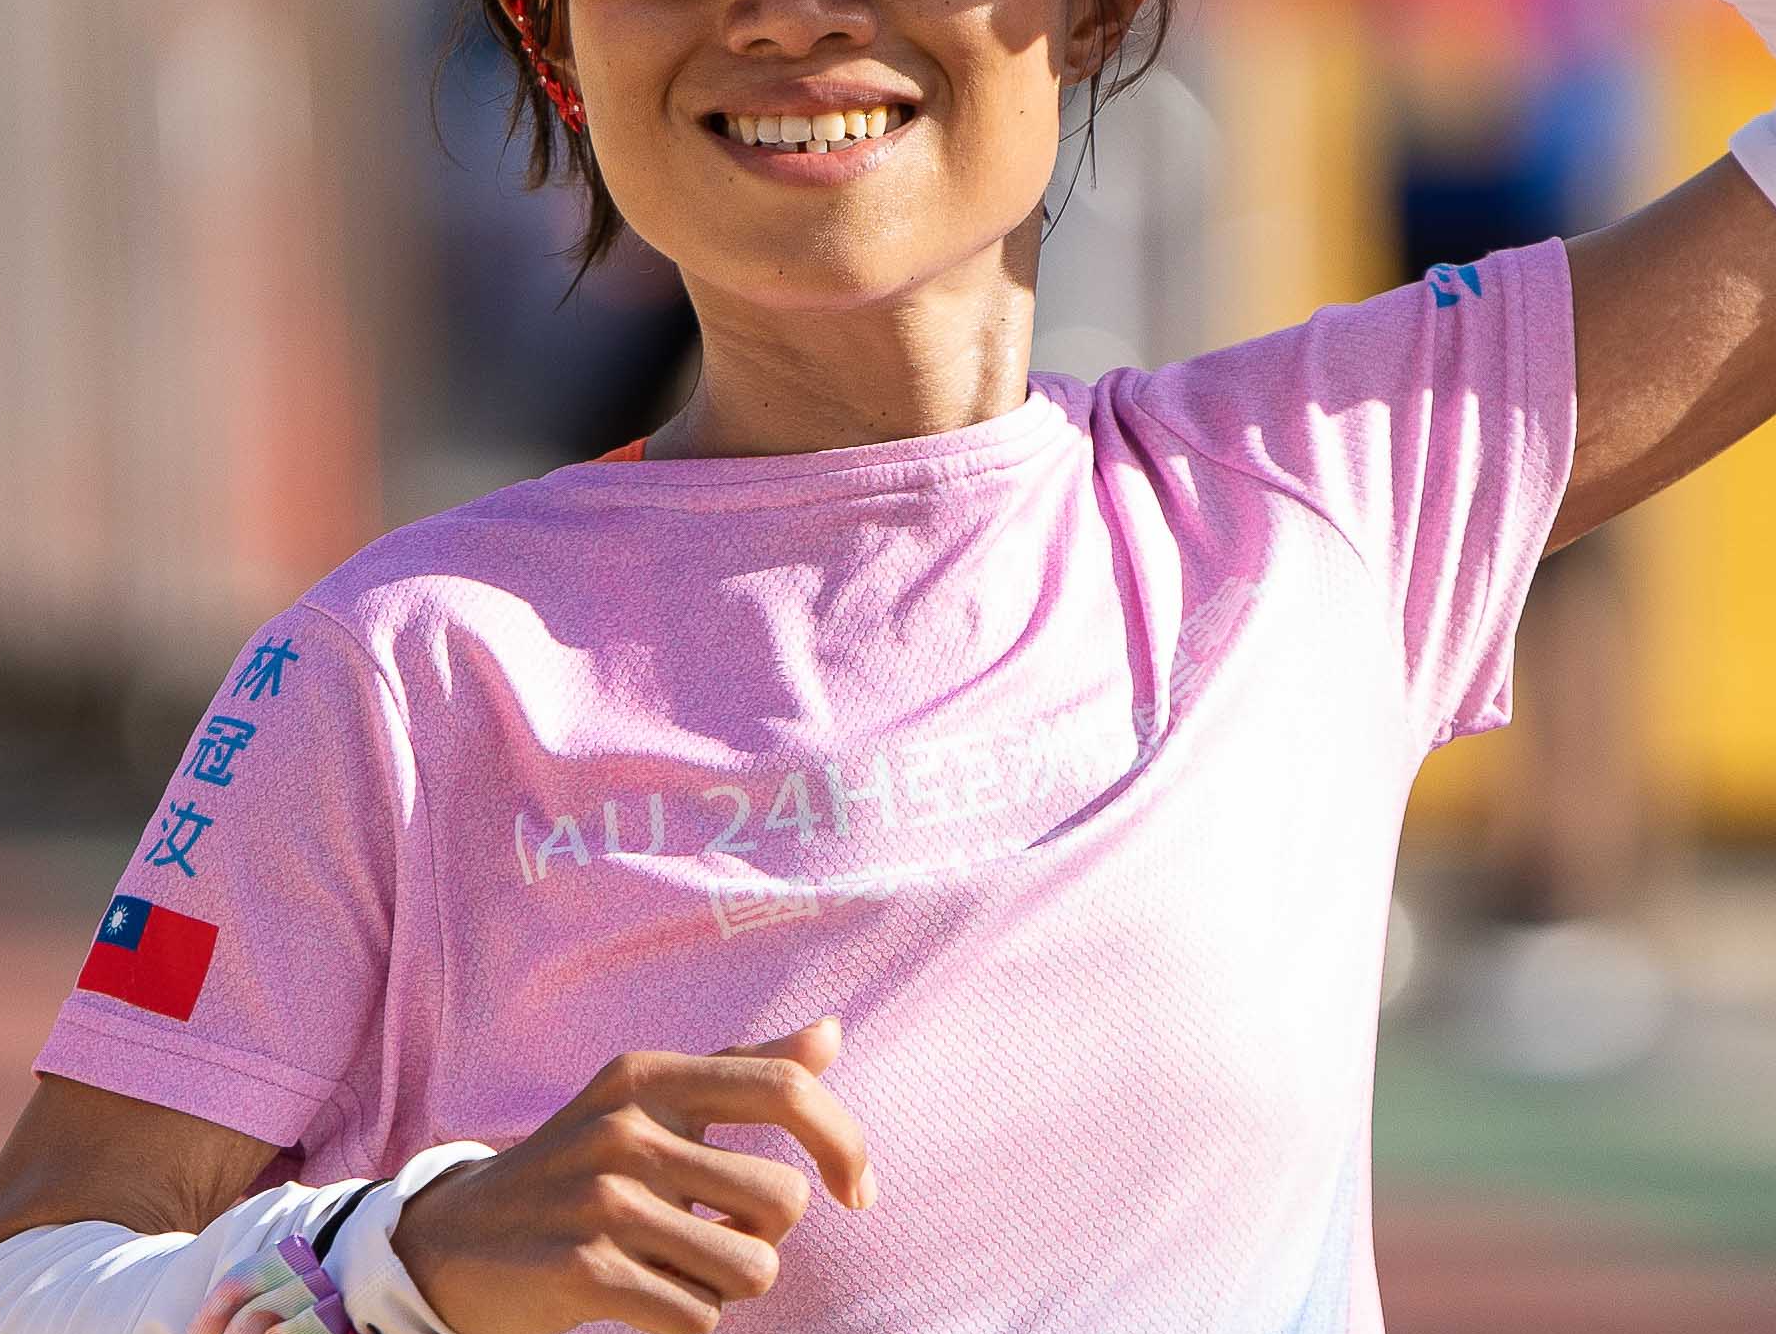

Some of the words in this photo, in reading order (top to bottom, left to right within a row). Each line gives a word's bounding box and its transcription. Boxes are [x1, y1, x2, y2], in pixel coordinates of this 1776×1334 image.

[144, 636, 301, 878] 林冠汝
[514, 789, 666, 886] IAU
